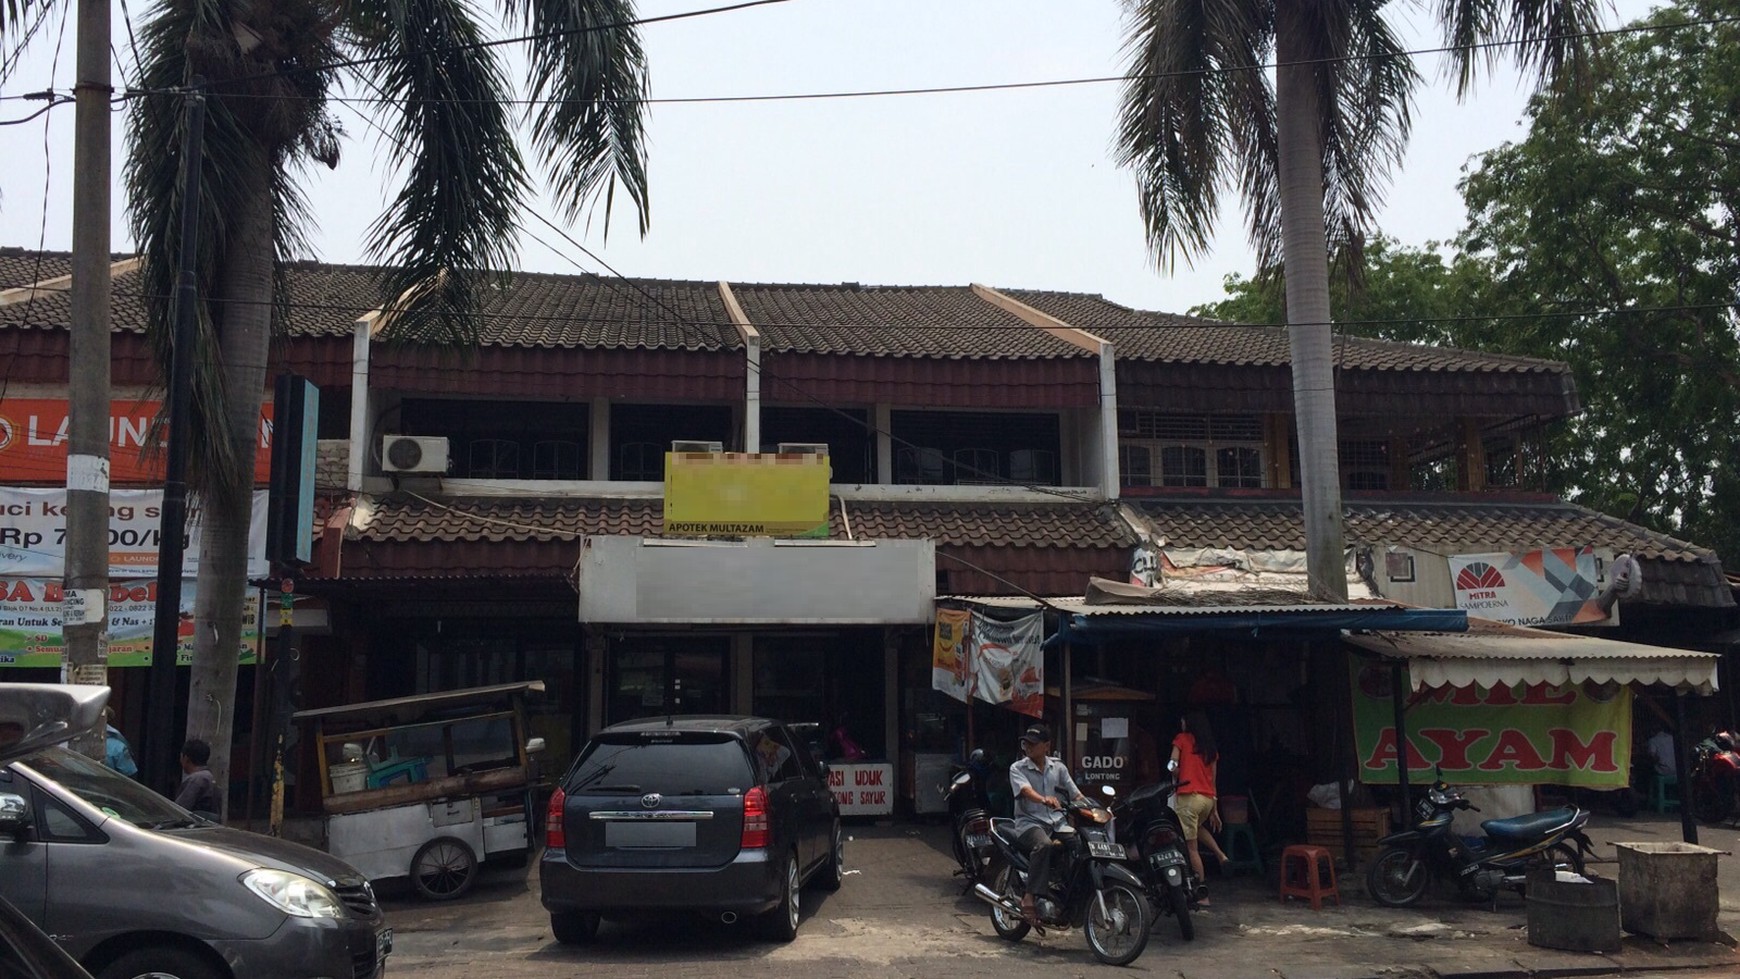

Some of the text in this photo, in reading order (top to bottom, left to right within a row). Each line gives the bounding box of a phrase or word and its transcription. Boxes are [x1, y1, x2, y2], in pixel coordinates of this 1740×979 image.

[669, 524, 707, 532] APOTEK
[709, 524, 764, 533] MULTAZAM
[1469, 591, 1497, 600] MITRA
[1459, 600, 1510, 610] SAMPOERNA
[18, 617, 49, 626] Untuk
[122, 617, 139, 625] Nas
[1518, 616, 1546, 625] NAGA
[1364, 727, 1620, 772] AYAM
[1081, 755, 1124, 769] GADO
[827, 770, 883, 786] ASI UDUK
[860, 791, 886, 805] SAYUR
